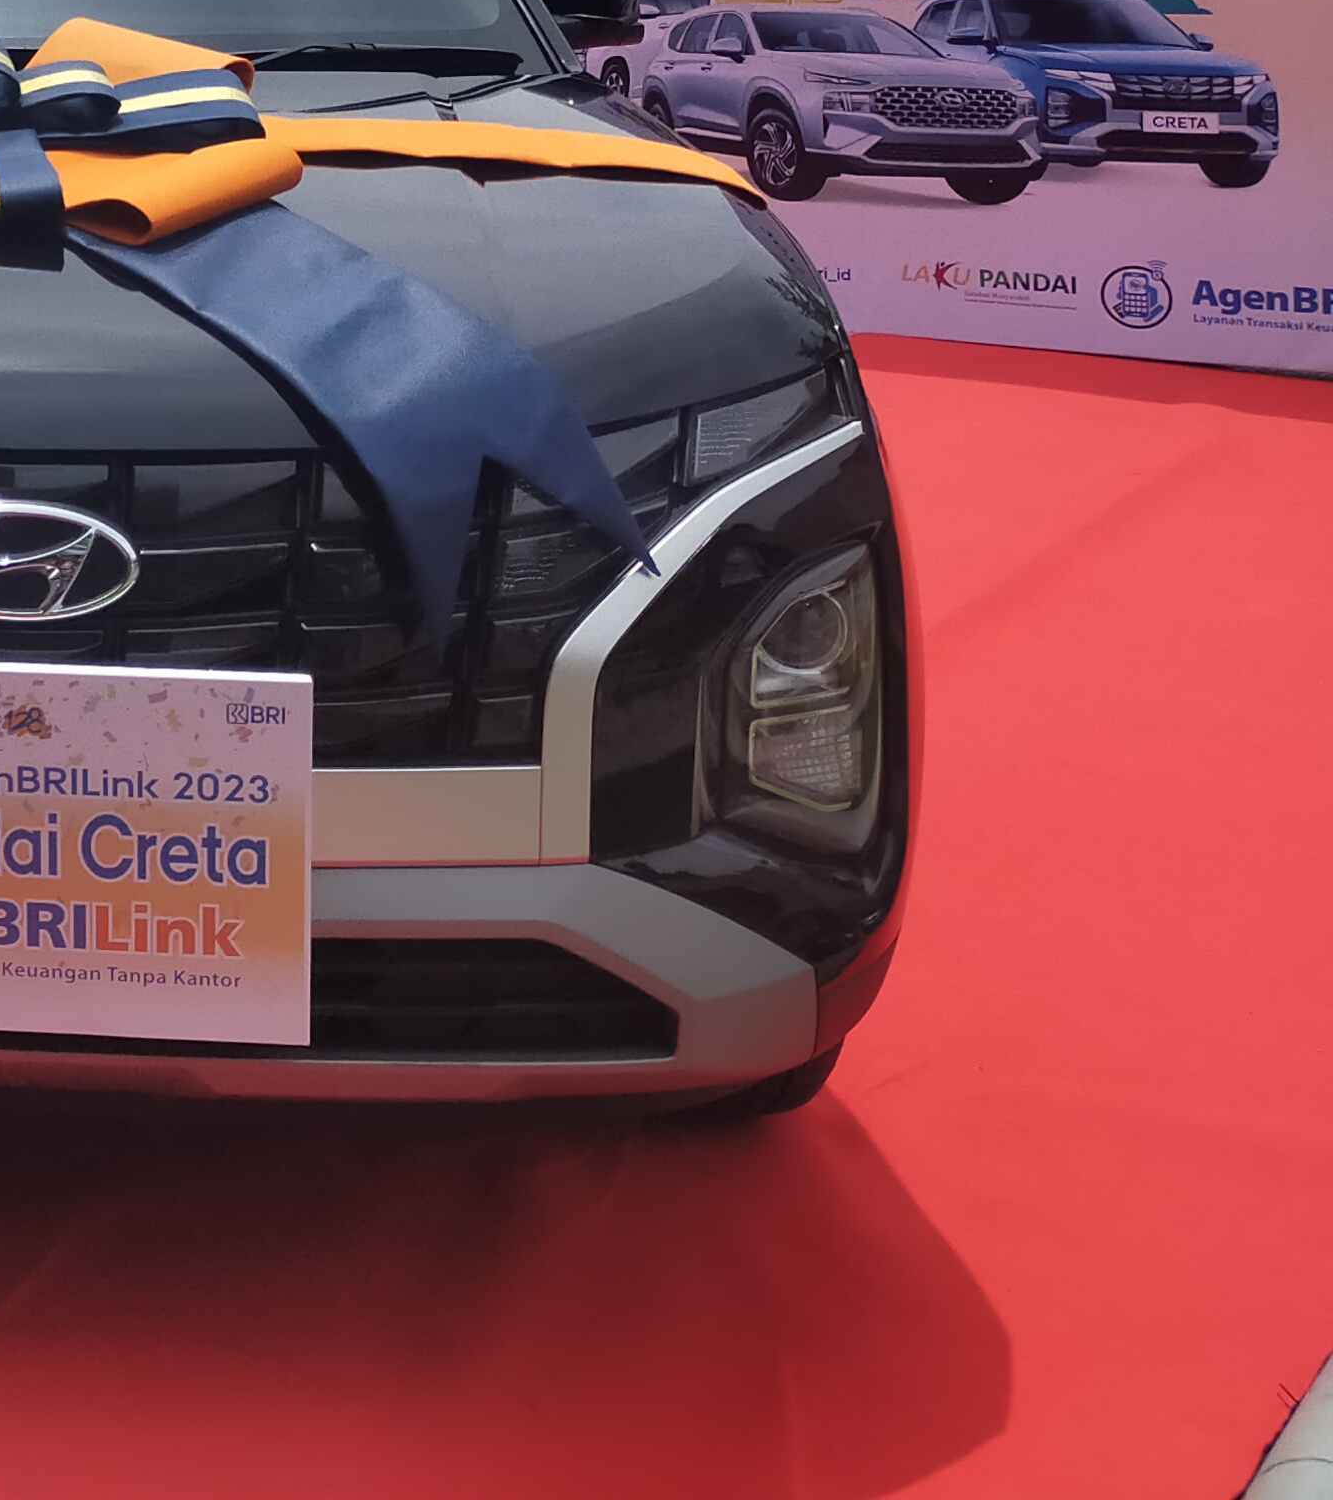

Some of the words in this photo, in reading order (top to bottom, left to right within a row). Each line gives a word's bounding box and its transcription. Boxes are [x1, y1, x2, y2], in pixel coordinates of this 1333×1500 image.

[1152, 115, 1209, 130] CRETA
[901, 261, 972, 291] LAKU
[979, 269, 1077, 295] PANDAI
[1193, 314, 1244, 326] Layanan
[1245, 317, 1304, 331] Transaksi
[251, 705, 286, 725] BRI
[173, 771, 271, 804] 2023
[80, 813, 270, 885] Creta
[1, 961, 102, 984] Keuangan
[107, 966, 167, 987] Tanpa
[173, 970, 242, 988] Kantor
